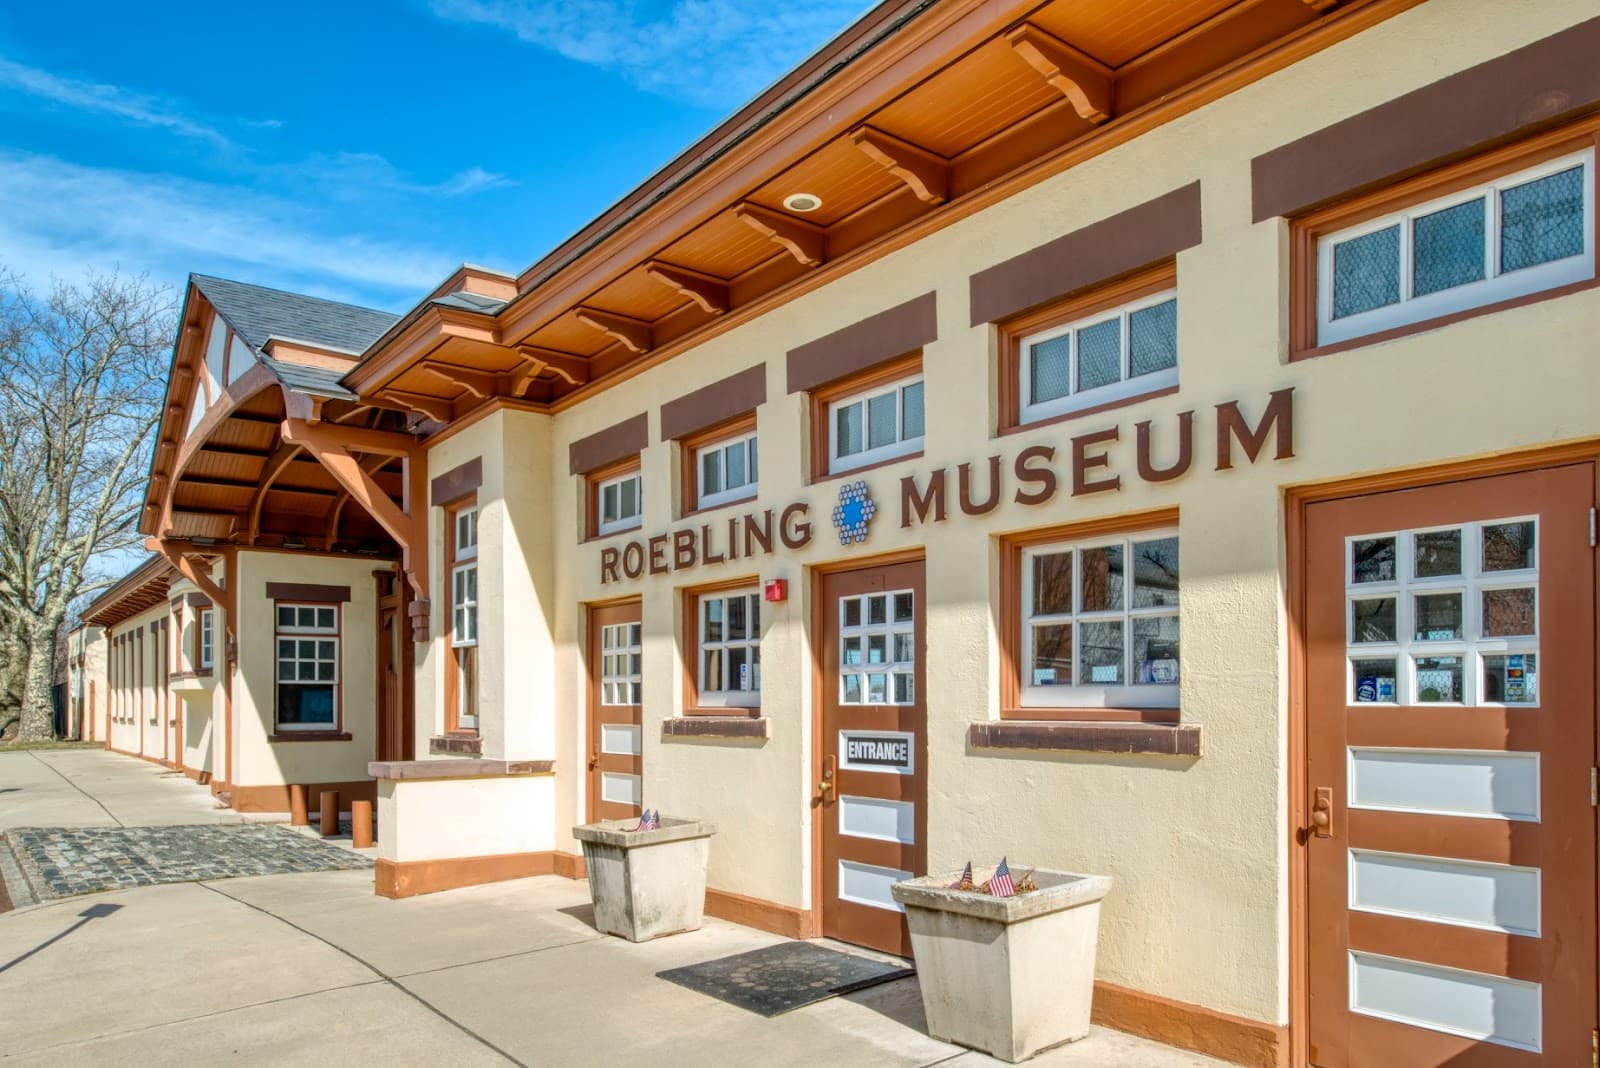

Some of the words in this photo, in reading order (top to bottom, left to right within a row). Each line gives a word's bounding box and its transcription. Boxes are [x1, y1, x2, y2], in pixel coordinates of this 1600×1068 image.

[600, 502, 812, 584] ROEBLING
[900, 387, 1295, 527] MUSEUM
[848, 741, 907, 761] ENTRANCE
